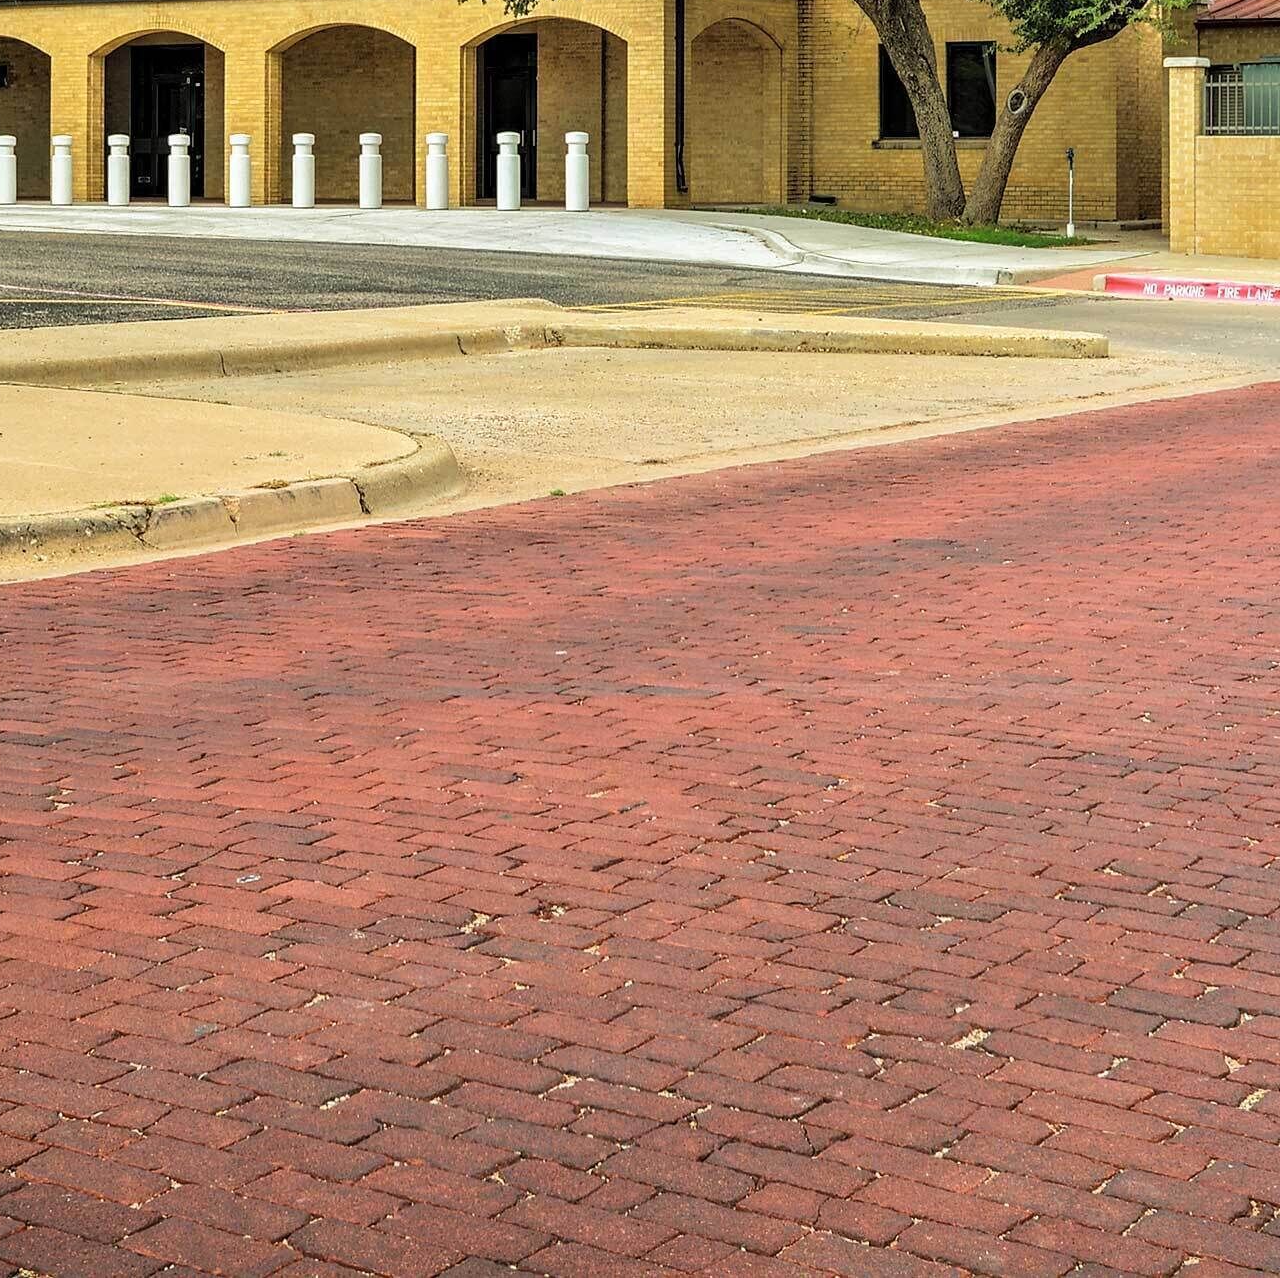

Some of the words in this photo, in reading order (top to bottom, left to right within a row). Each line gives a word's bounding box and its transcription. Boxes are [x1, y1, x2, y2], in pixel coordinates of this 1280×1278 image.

[1143, 283, 1158, 295] NO
[1164, 284, 1206, 297] PARKING
[1217, 286, 1241, 299] FIRE
[1247, 288, 1275, 301] LANE
